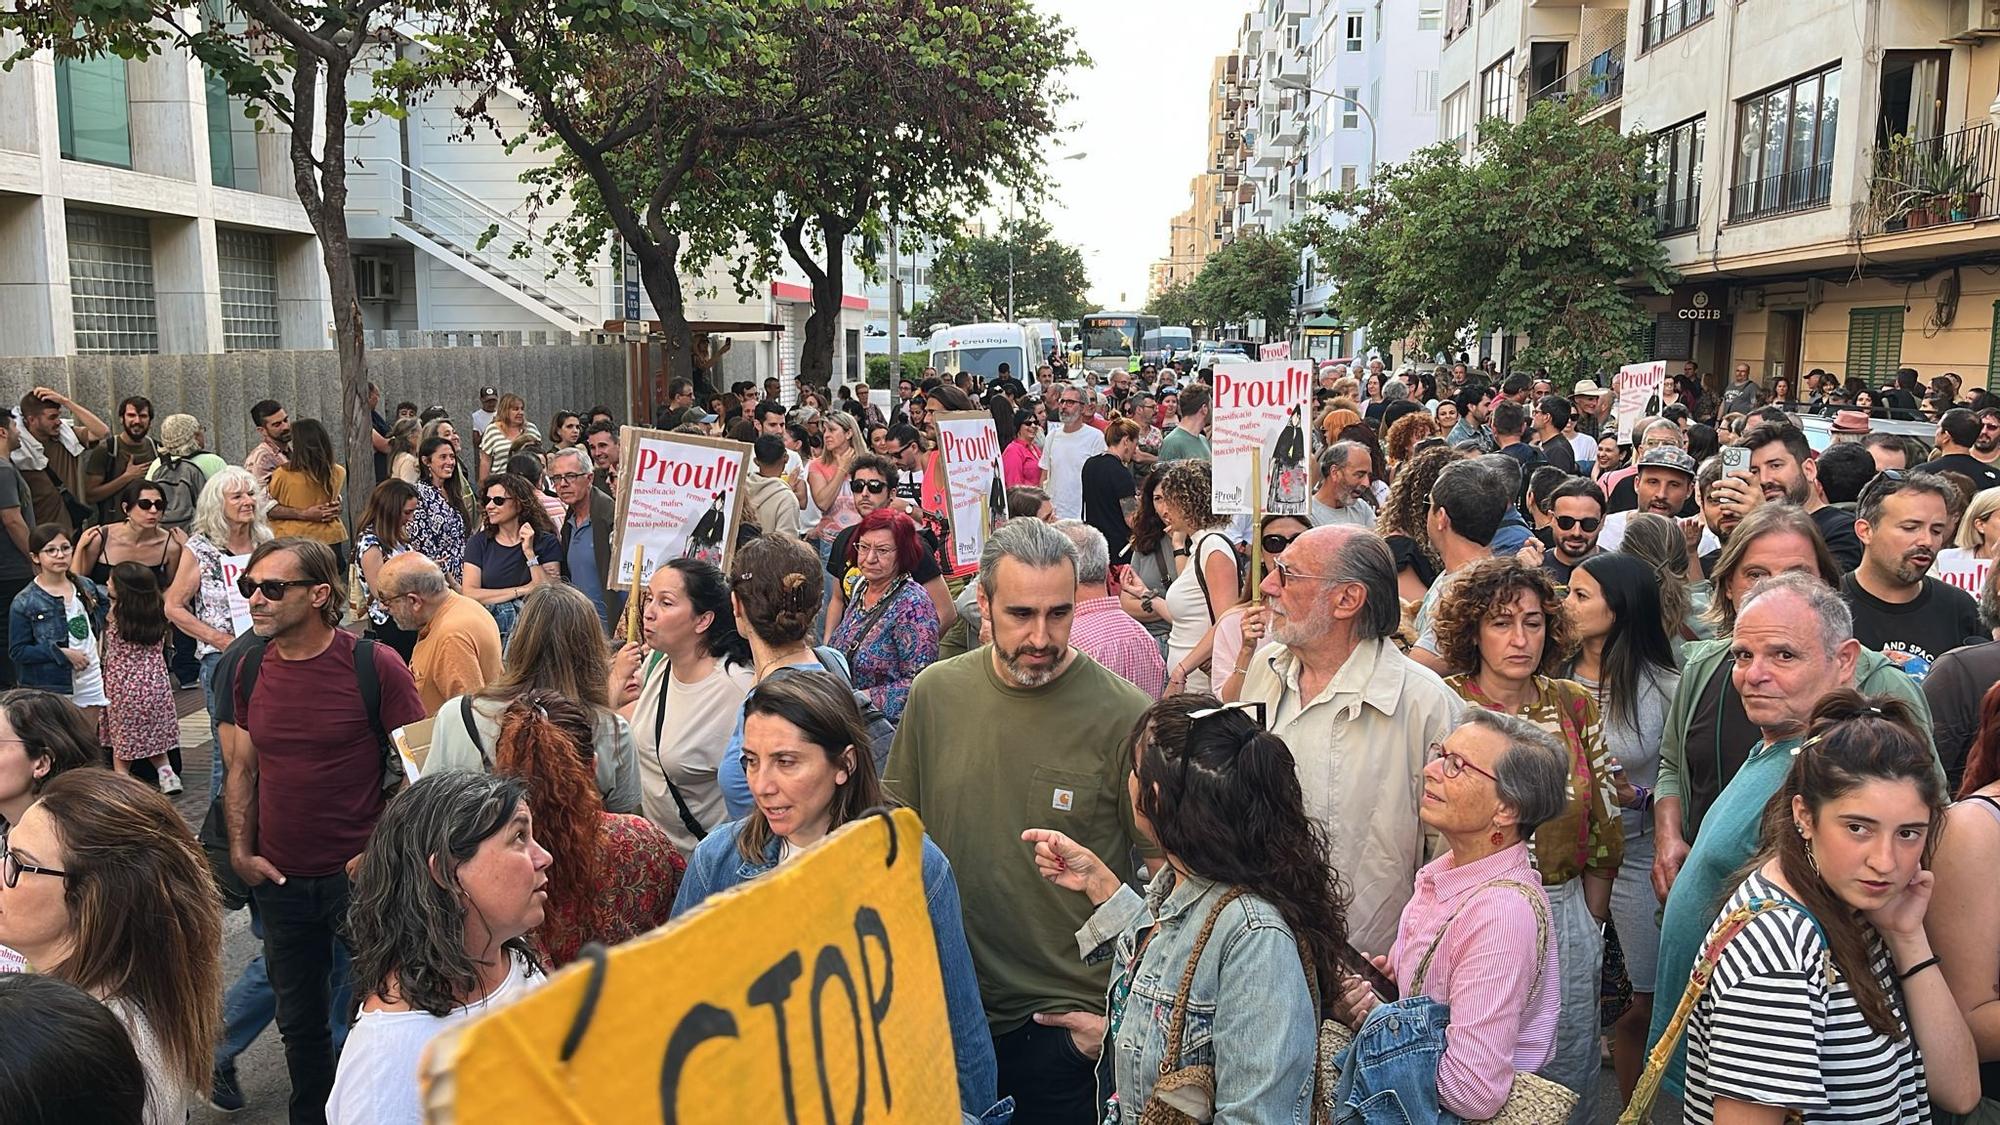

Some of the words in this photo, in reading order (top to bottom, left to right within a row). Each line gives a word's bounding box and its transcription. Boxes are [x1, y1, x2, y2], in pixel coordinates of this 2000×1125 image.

[1678, 309, 1721, 320] COEIB
[986, 337, 1008, 345] Roja
[1214, 367, 1309, 416] Prou!!!
[942, 425, 1001, 468] Prou!!!
[635, 448, 738, 500] Prou!!!
[1883, 641, 1906, 651] AND
[1908, 644, 1935, 663] SPAC
